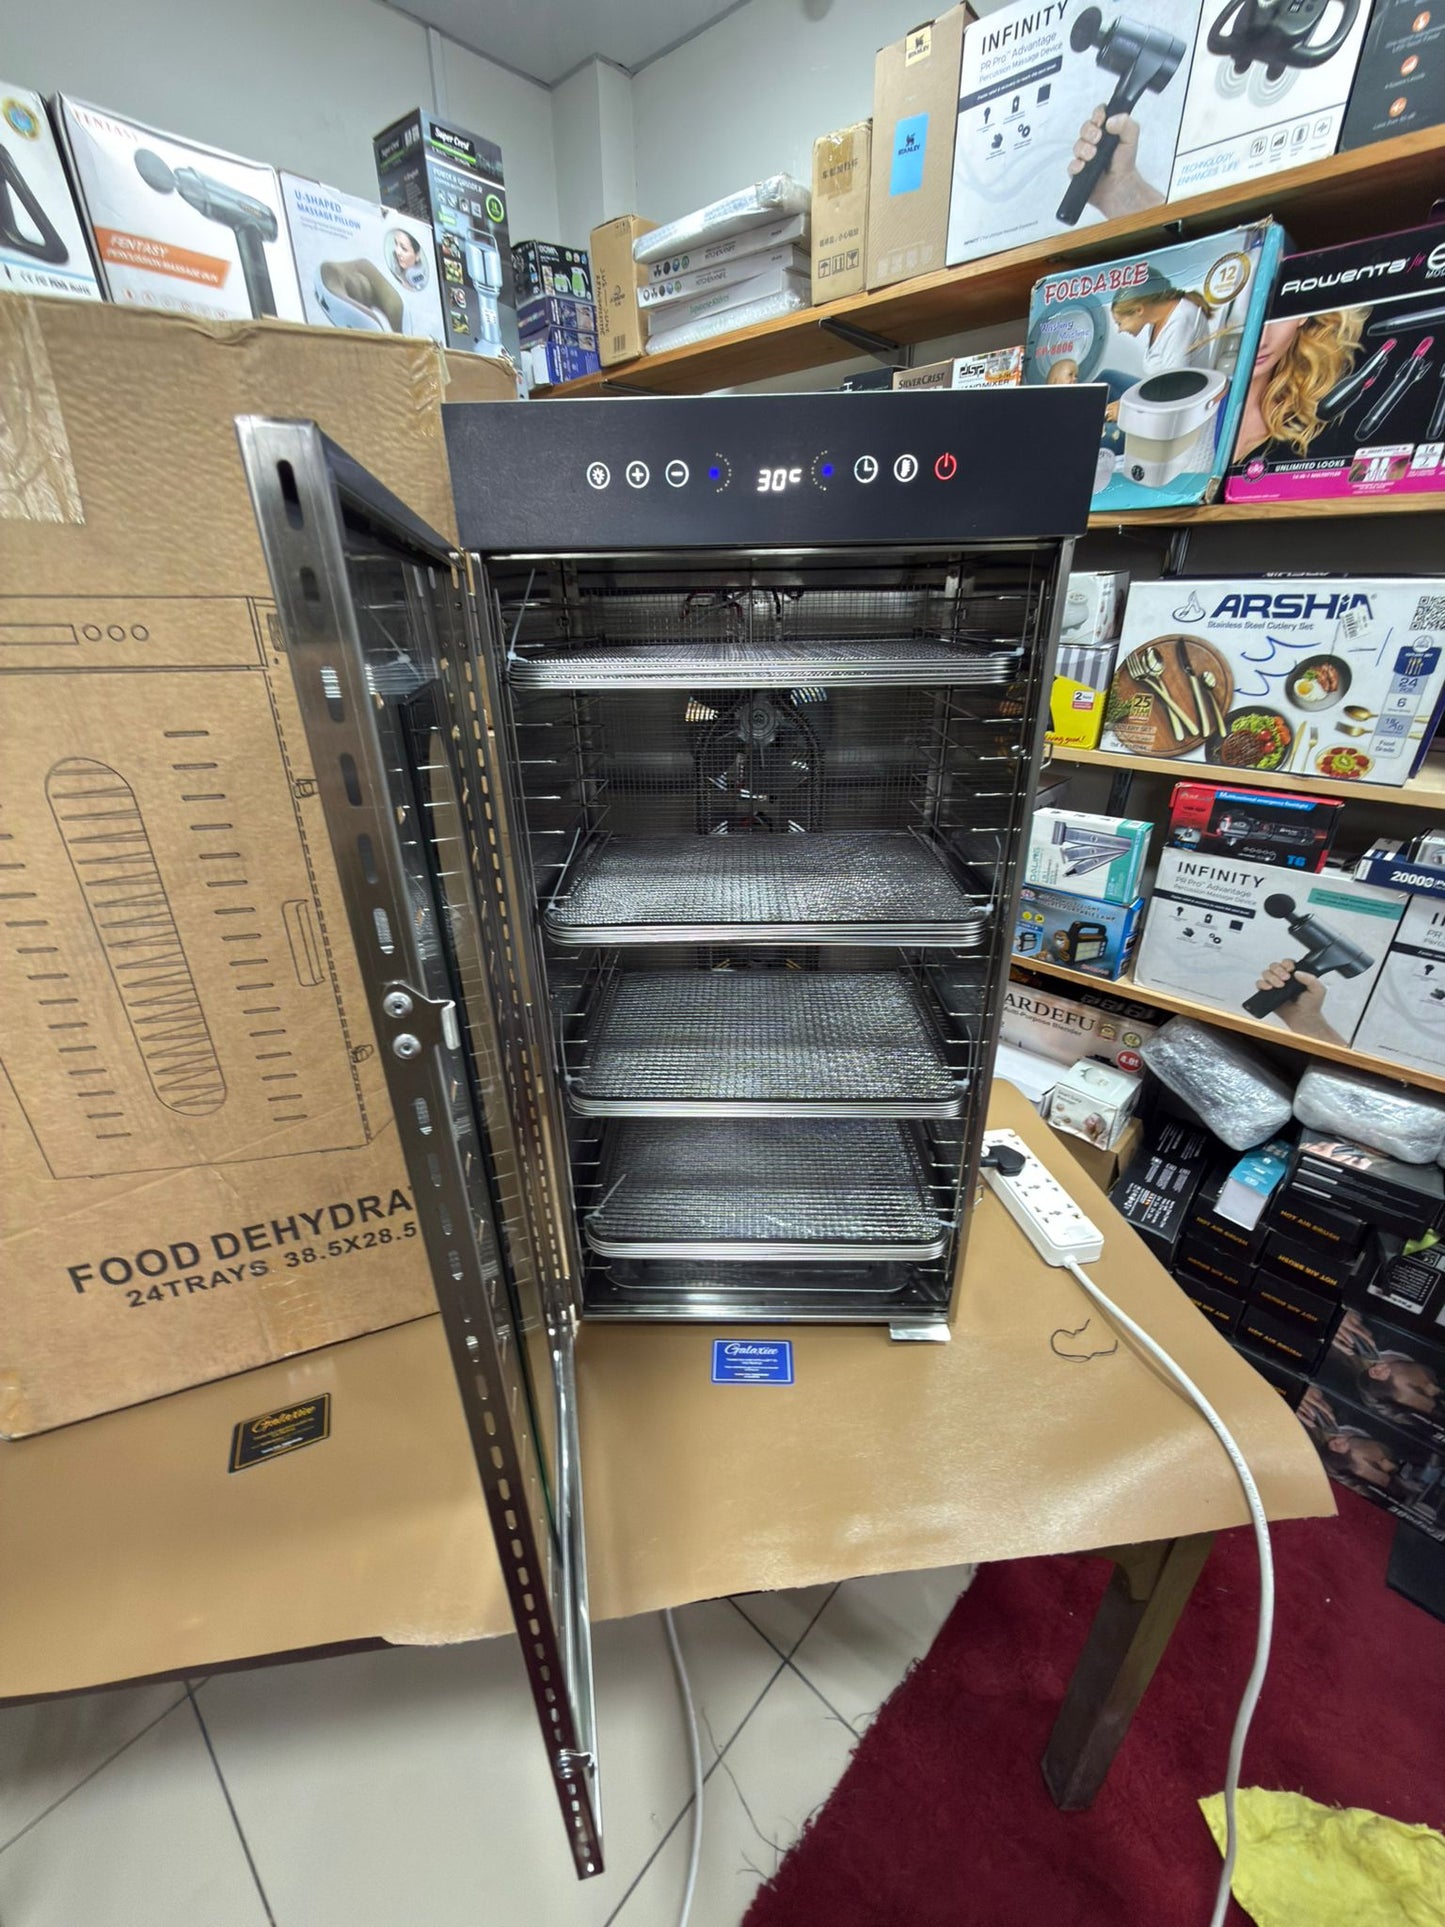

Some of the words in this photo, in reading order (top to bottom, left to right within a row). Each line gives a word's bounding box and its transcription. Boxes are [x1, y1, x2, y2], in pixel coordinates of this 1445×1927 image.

[981, 0, 1068, 55] INFINITY
[908, 44, 930, 60] STANLEY
[1012, 33, 1057, 59] Advantage
[898, 144, 921, 156] STANLEY
[1182, 152, 1234, 174] TECHNOLOGY
[294, 190, 342, 213] U-SHAPED
[296, 202, 333, 221] MASSAGE
[333, 214, 361, 229] PILLOW
[1220, 265, 1237, 282] 12
[1044, 261, 1149, 305] FOLDABLE
[1274, 463, 1315, 472] UNLIMITED
[1317, 459, 1345, 469] LOOKS
[1207, 620, 1243, 629] Stainless
[1244, 621, 1266, 630] Steel
[1267, 622, 1297, 632] Cutlery
[1298, 622, 1314, 630] Set
[1399, 677, 1418, 688] 24
[1075, 692, 1084, 701] 2
[1134, 696, 1151, 708] 25
[1397, 698, 1407, 708] 6
[1379, 739, 1396, 747] Food
[1178, 861, 1265, 888] INFINITY
[1206, 883, 1252, 898] Advantage
[1052, 1021, 1082, 1036] Blender
[1196, 1216, 1211, 1227] HOT
[1212, 1224, 1224, 1233] AIR
[1224, 1231, 1249, 1246] BRUSH
[1280, 1210, 1296, 1220] HOT
[1297, 1218, 1311, 1228] AIR
[1312, 1225, 1341, 1241] BRUSH
[67, 1241, 200, 1294] FOOD
[212, 1184, 413, 1260] DEHYDRA
[1278, 1255, 1305, 1272] BRUSH
[1305, 1267, 1319, 1280] AIR
[1320, 1274, 1338, 1286] HOT
[125, 1260, 269, 1308] 24TRAYS
